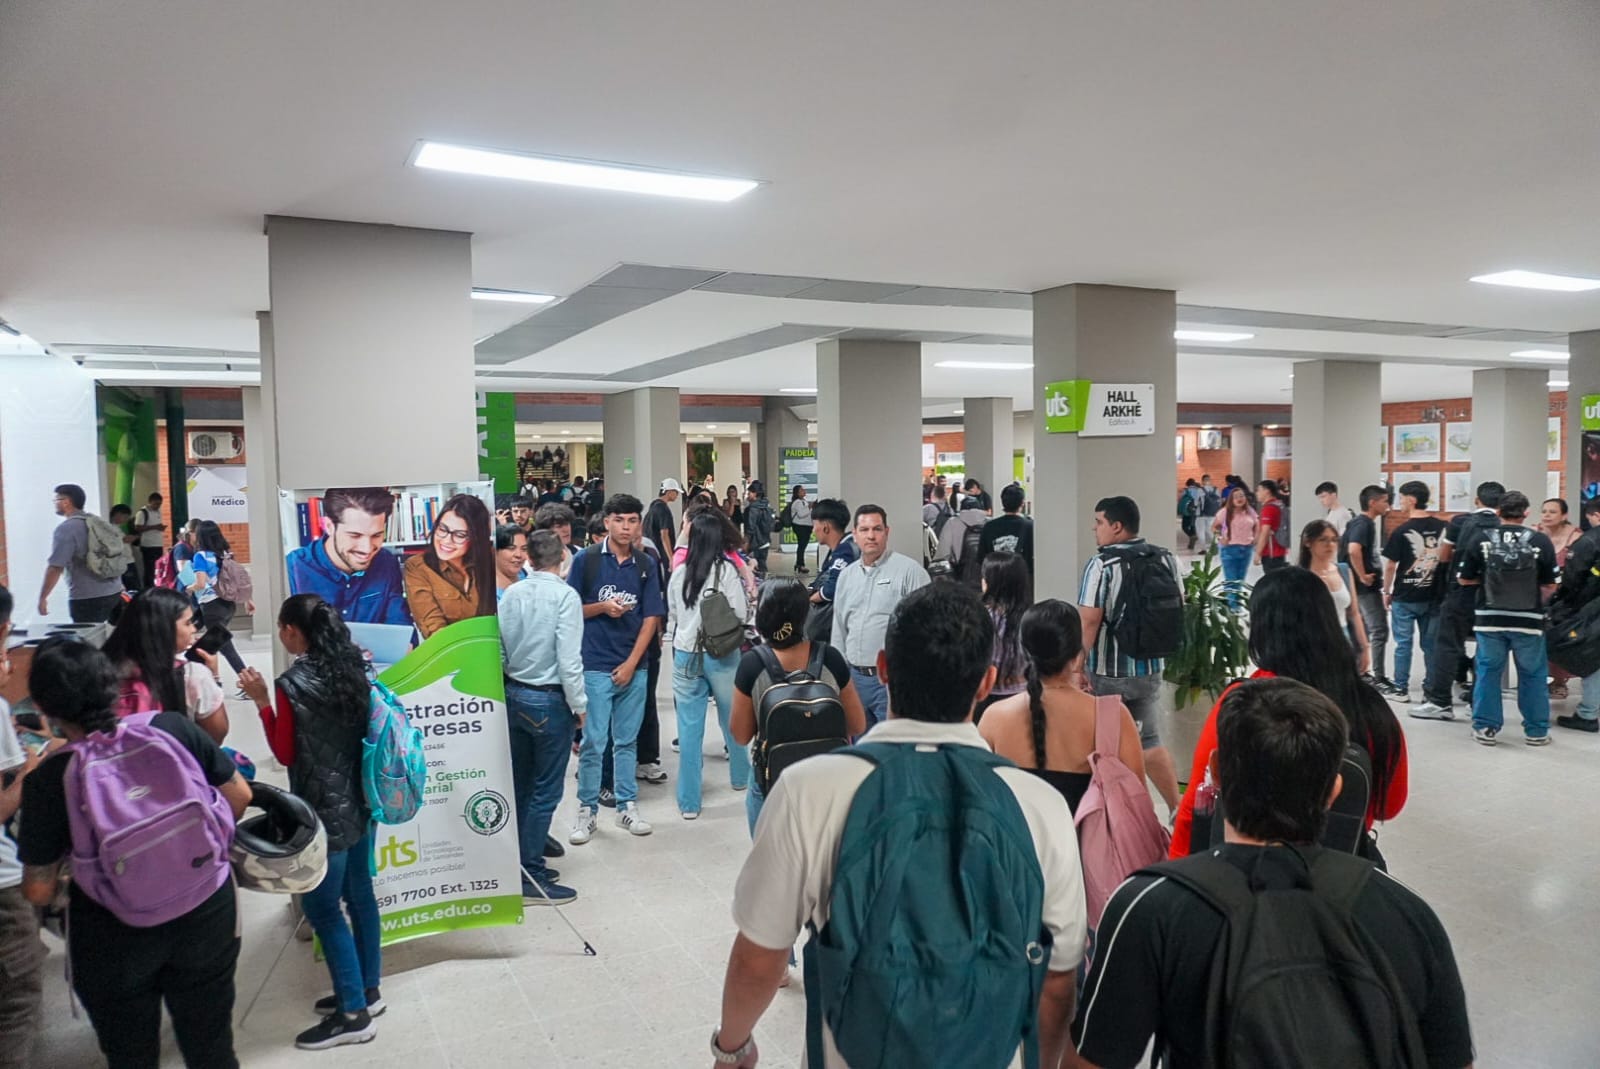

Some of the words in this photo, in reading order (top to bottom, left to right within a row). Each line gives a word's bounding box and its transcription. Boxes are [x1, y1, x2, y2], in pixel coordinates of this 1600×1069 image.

[1107, 391, 1137, 402] HALL
[1046, 391, 1070, 418] uts
[1103, 401, 1142, 418] ARKHÉ
[211, 498, 245, 506] Médico
[435, 768, 487, 782] Gestión
[401, 886, 437, 902] 7700
[440, 882, 468, 896] Ext.
[469, 879, 499, 892] 1325
